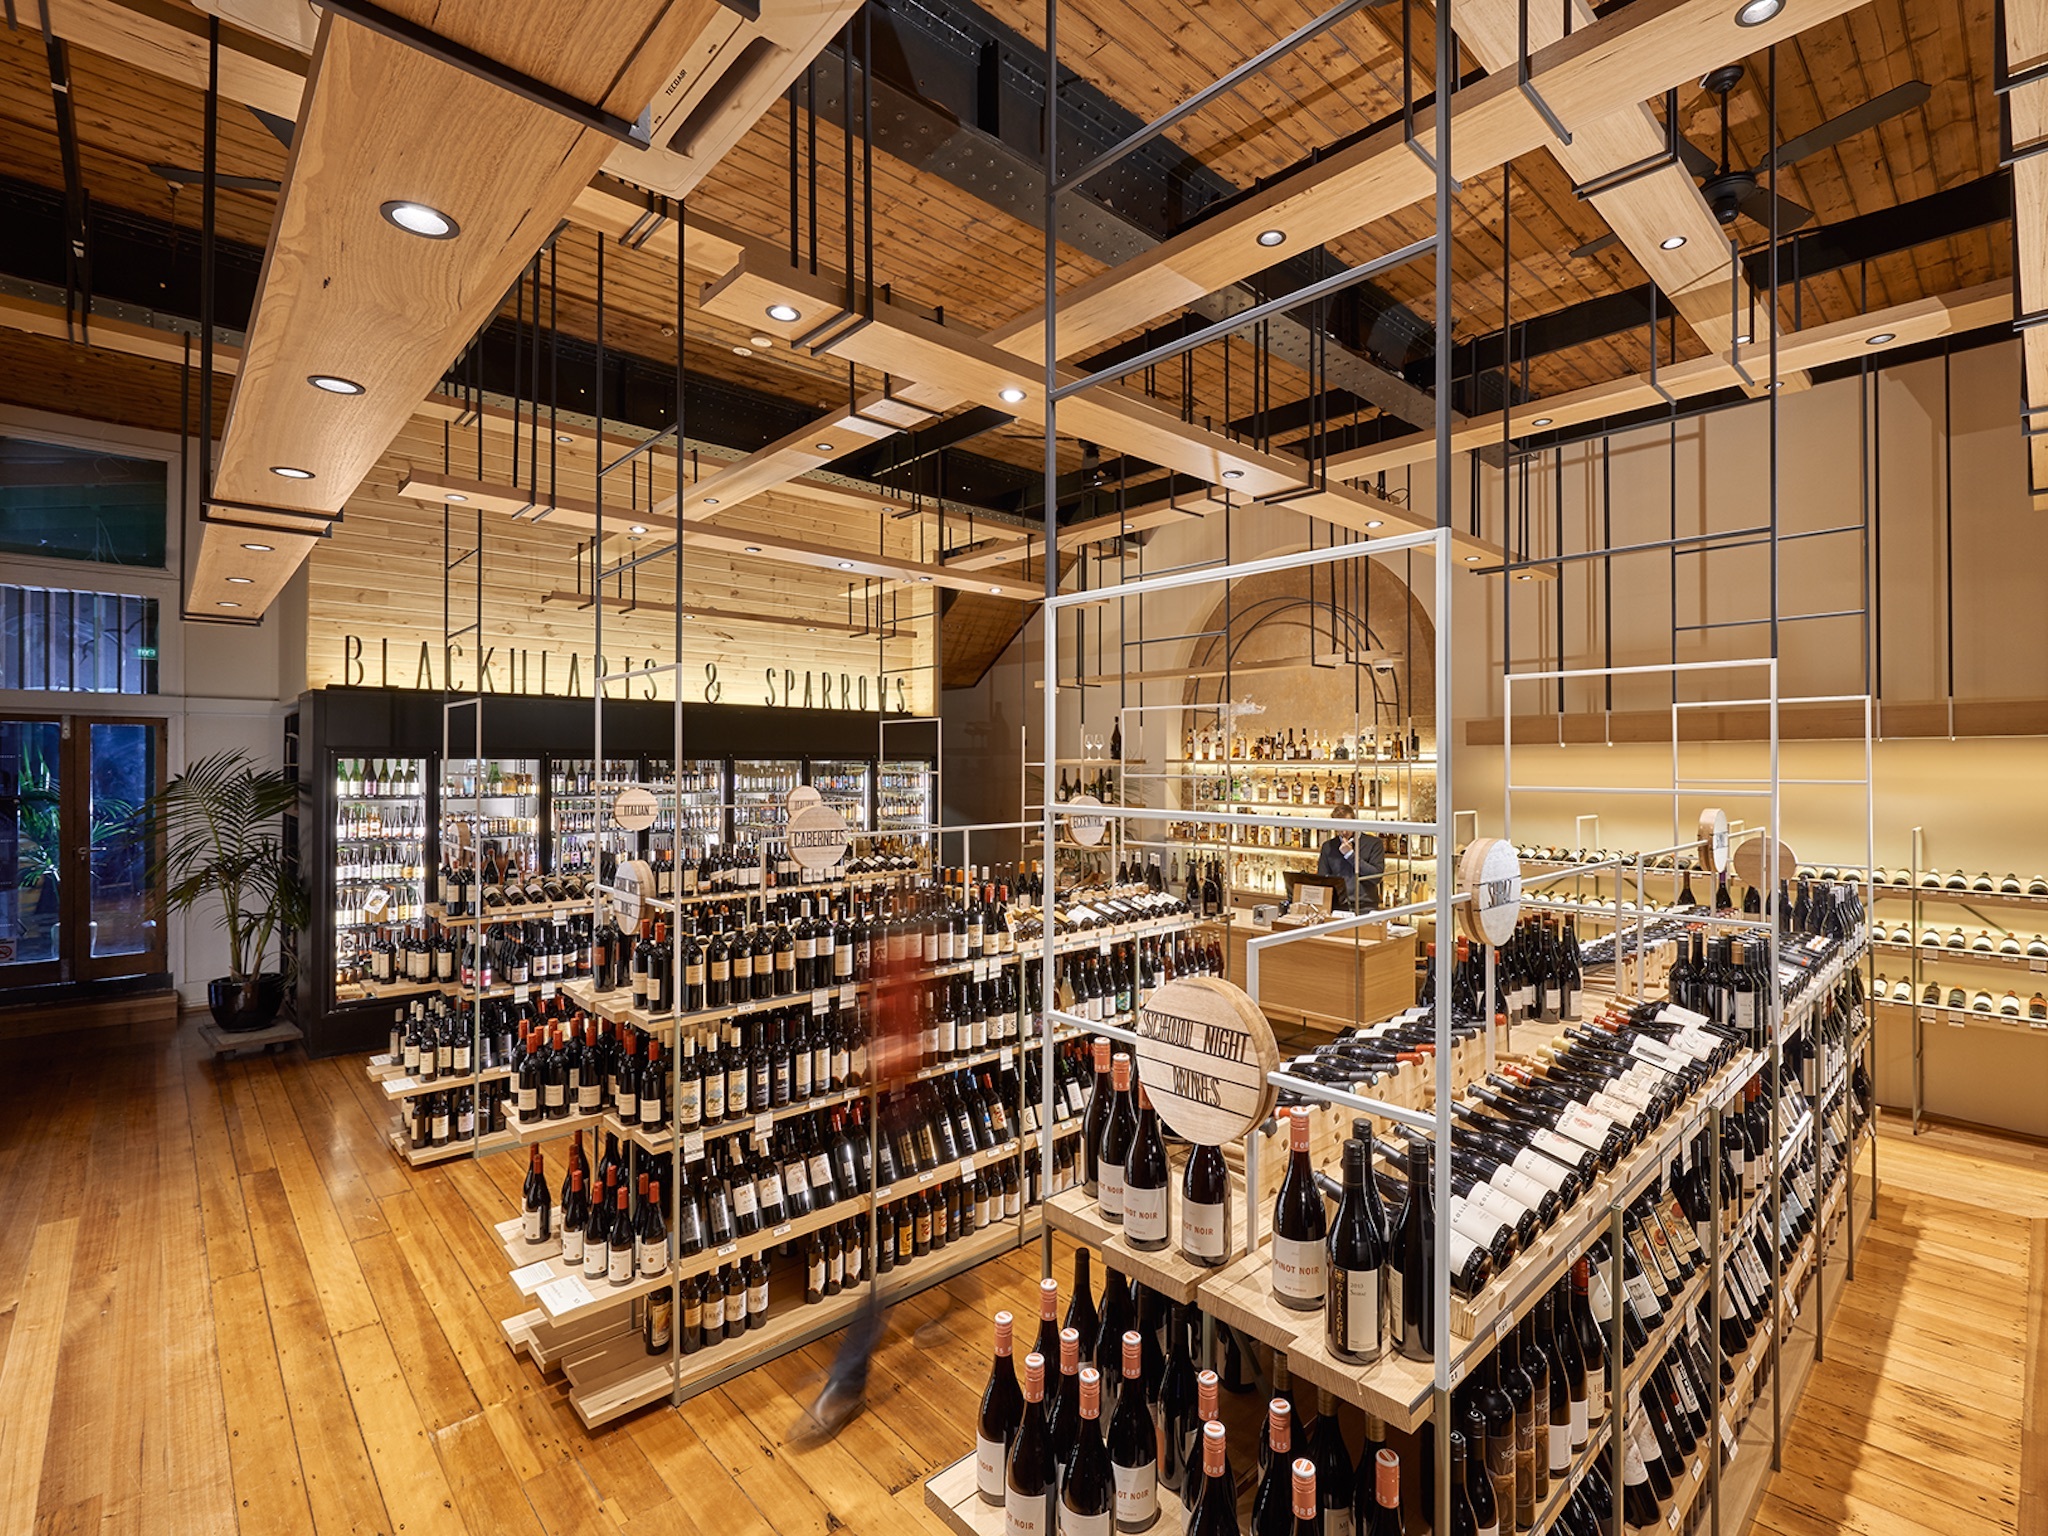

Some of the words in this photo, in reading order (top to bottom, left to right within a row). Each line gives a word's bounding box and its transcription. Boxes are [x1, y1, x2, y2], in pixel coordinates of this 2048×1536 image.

[704, 662, 723, 704] &
[765, 667, 906, 713] SPARROWS
[623, 804, 650, 817] ITALIAN
[794, 830, 847, 847] CABERNETS
[1141, 1011, 1195, 1049] SCHOOL
[1203, 1025, 1250, 1063] NIGHT
[1172, 1066, 1222, 1108] WINES
[1107, 1186, 1124, 1195] NOIR
[1138, 1211, 1158, 1220] NOIR
[1194, 1226, 1214, 1236] NOIR
[1275, 1258, 1296, 1274] PINOT
[1298, 1266, 1320, 1275] NOIR
[1130, 1489, 1149, 1500] NOIR
[1014, 1519, 1035, 1531] NOIR
